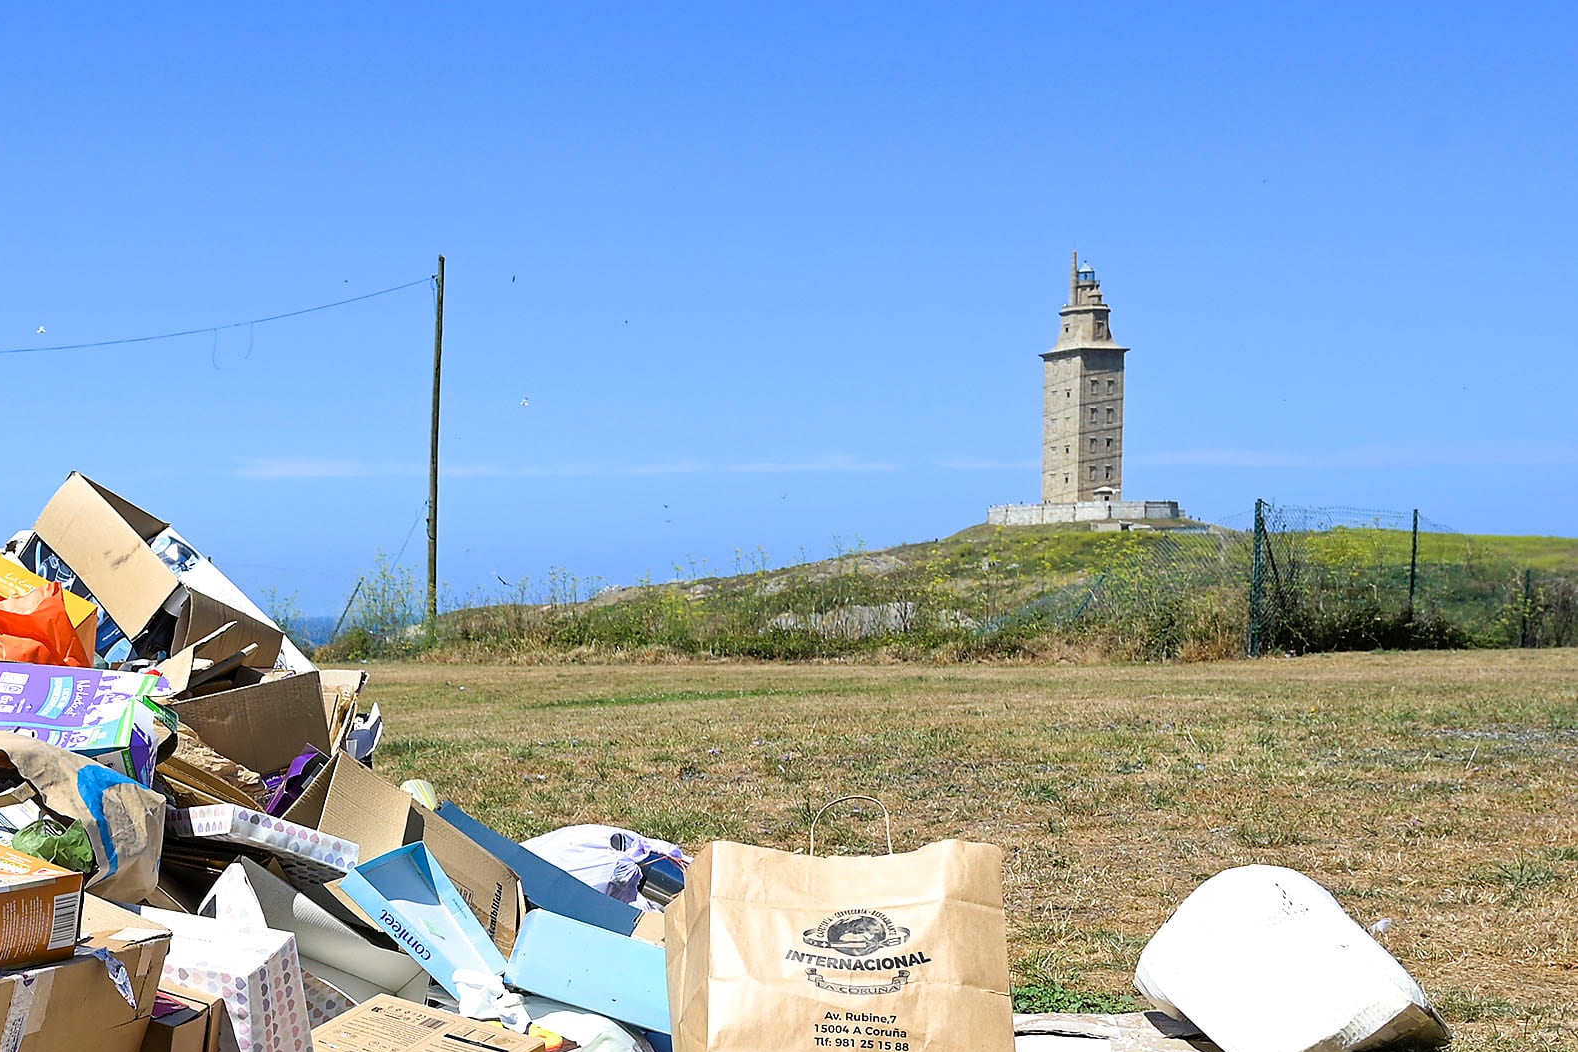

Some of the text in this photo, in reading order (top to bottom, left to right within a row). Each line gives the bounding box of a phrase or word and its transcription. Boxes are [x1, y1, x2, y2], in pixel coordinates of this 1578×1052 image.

[380, 909, 432, 961] comfeet
[785, 949, 932, 971] INTERNACIONAL
[824, 1011, 897, 1025] Av. Rubine,7
[814, 1023, 908, 1039] 15004 A Coruña
[814, 1037, 910, 1052] Tlf: 981 25 15 88
